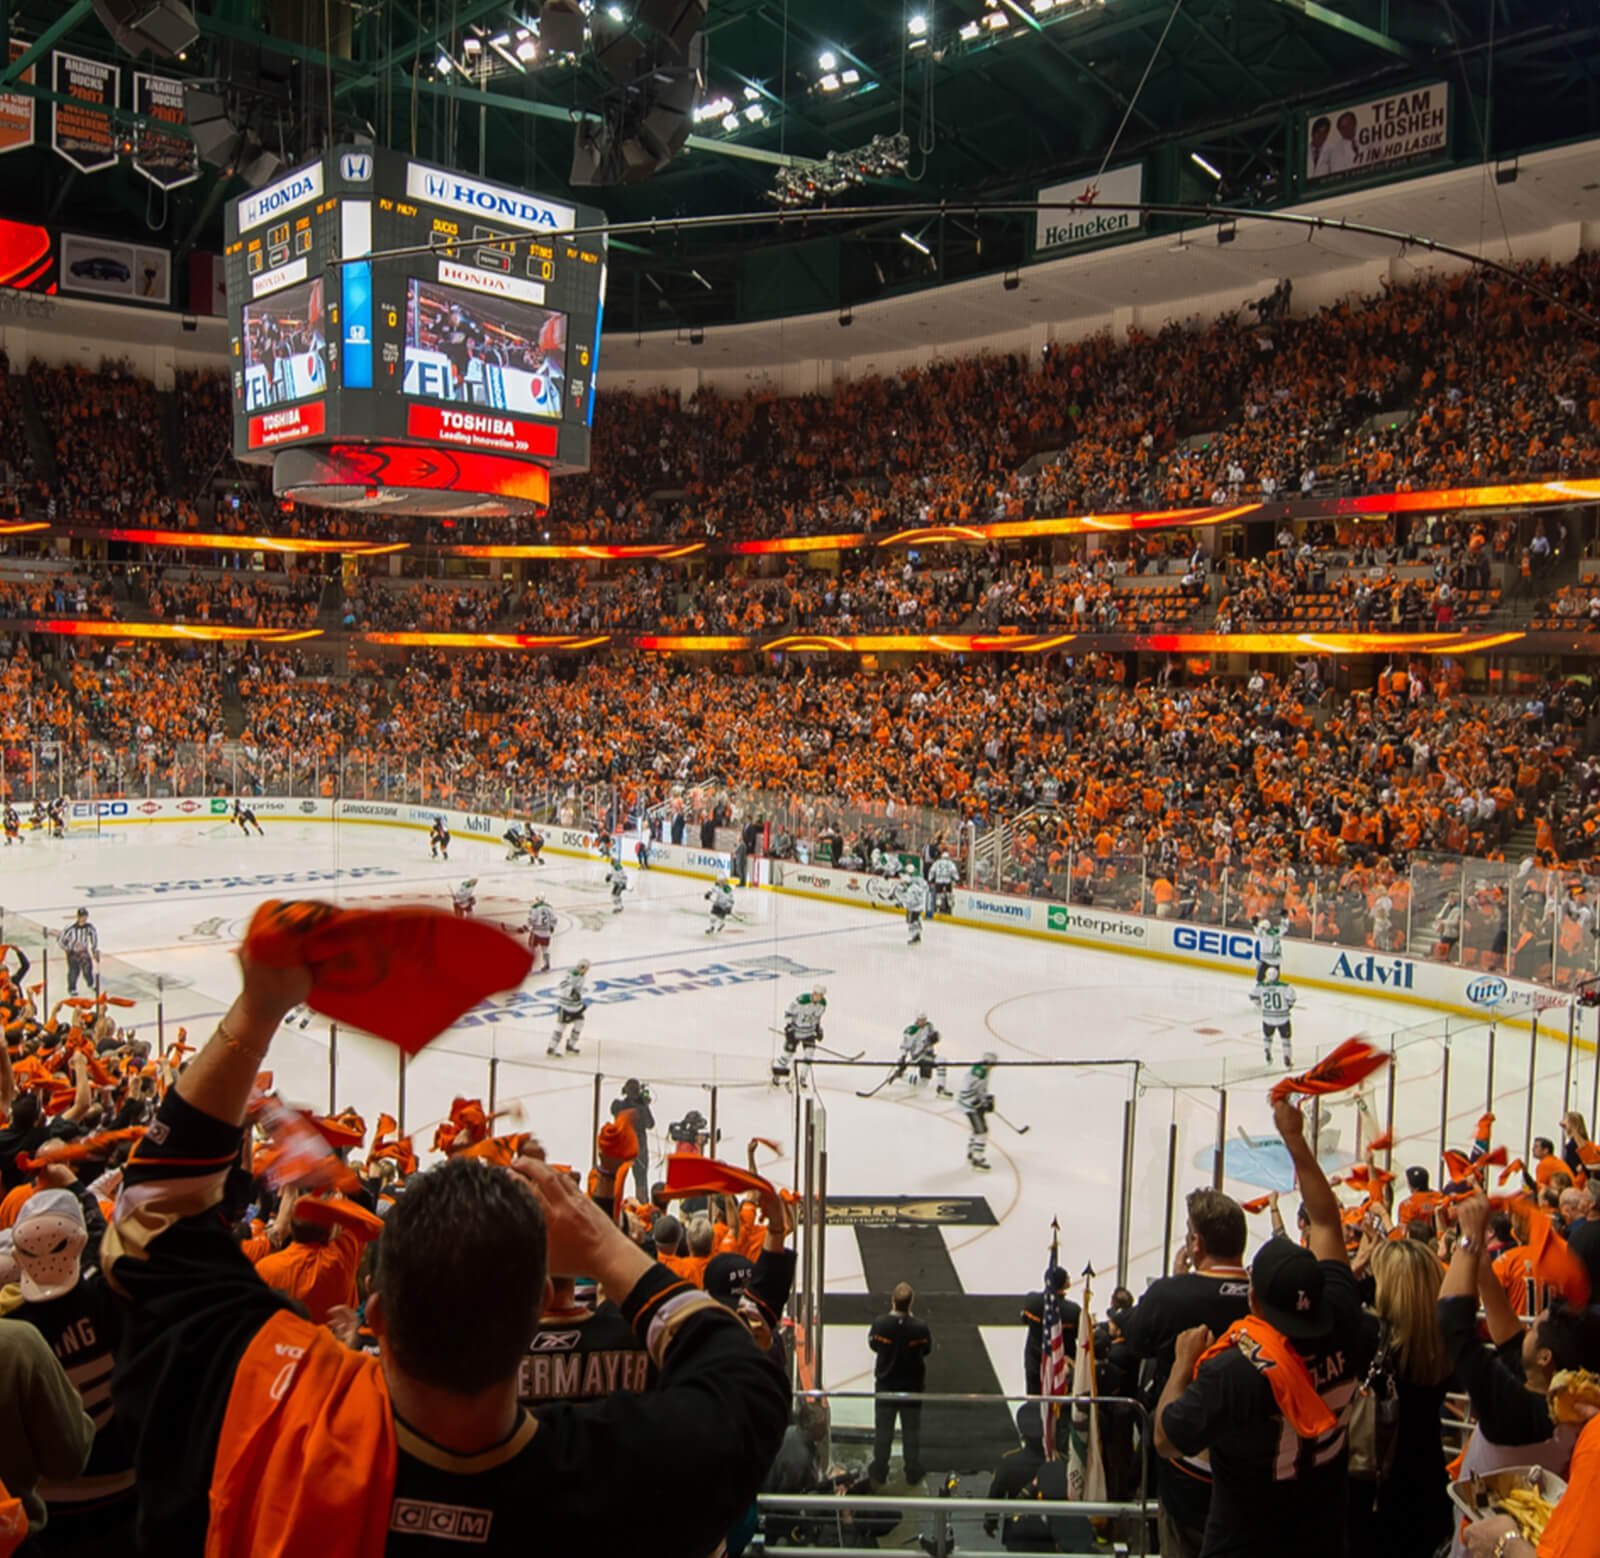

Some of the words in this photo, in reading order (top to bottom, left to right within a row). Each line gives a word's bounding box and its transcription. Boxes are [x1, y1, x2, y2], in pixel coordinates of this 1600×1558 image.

[65, 59, 109, 79] ANAHEIM
[70, 72, 104, 90] DUCKS
[145, 79, 184, 97] ANAHEI
[69, 86, 104, 105] 2007
[151, 93, 184, 109] DUCKS
[1371, 91, 1431, 123] TEAM
[1359, 108, 1445, 146] GHOSHEH
[1404, 132, 1443, 154] LASIK
[258, 176, 314, 216] HONDA
[453, 182, 558, 229] HONDA
[432, 218, 459, 235] DUCKS
[1045, 213, 1128, 246] Heineken
[443, 266, 506, 290] HONDA
[541, 261, 551, 279] 0
[263, 408, 300, 431] TOSHIBA
[441, 410, 516, 437] TOSHIBA
[439, 429, 472, 445] Leading
[66, 802, 128, 818] EICO
[464, 816, 490, 832] Advil
[1053, 909, 1145, 938] enterprise
[1173, 927, 1262, 960] GEIC
[1330, 951, 1414, 989] Advil
[1263, 990, 1283, 1009] 20
[1473, 983, 1503, 1003] Lite
[396, 1503, 489, 1538] CCM
